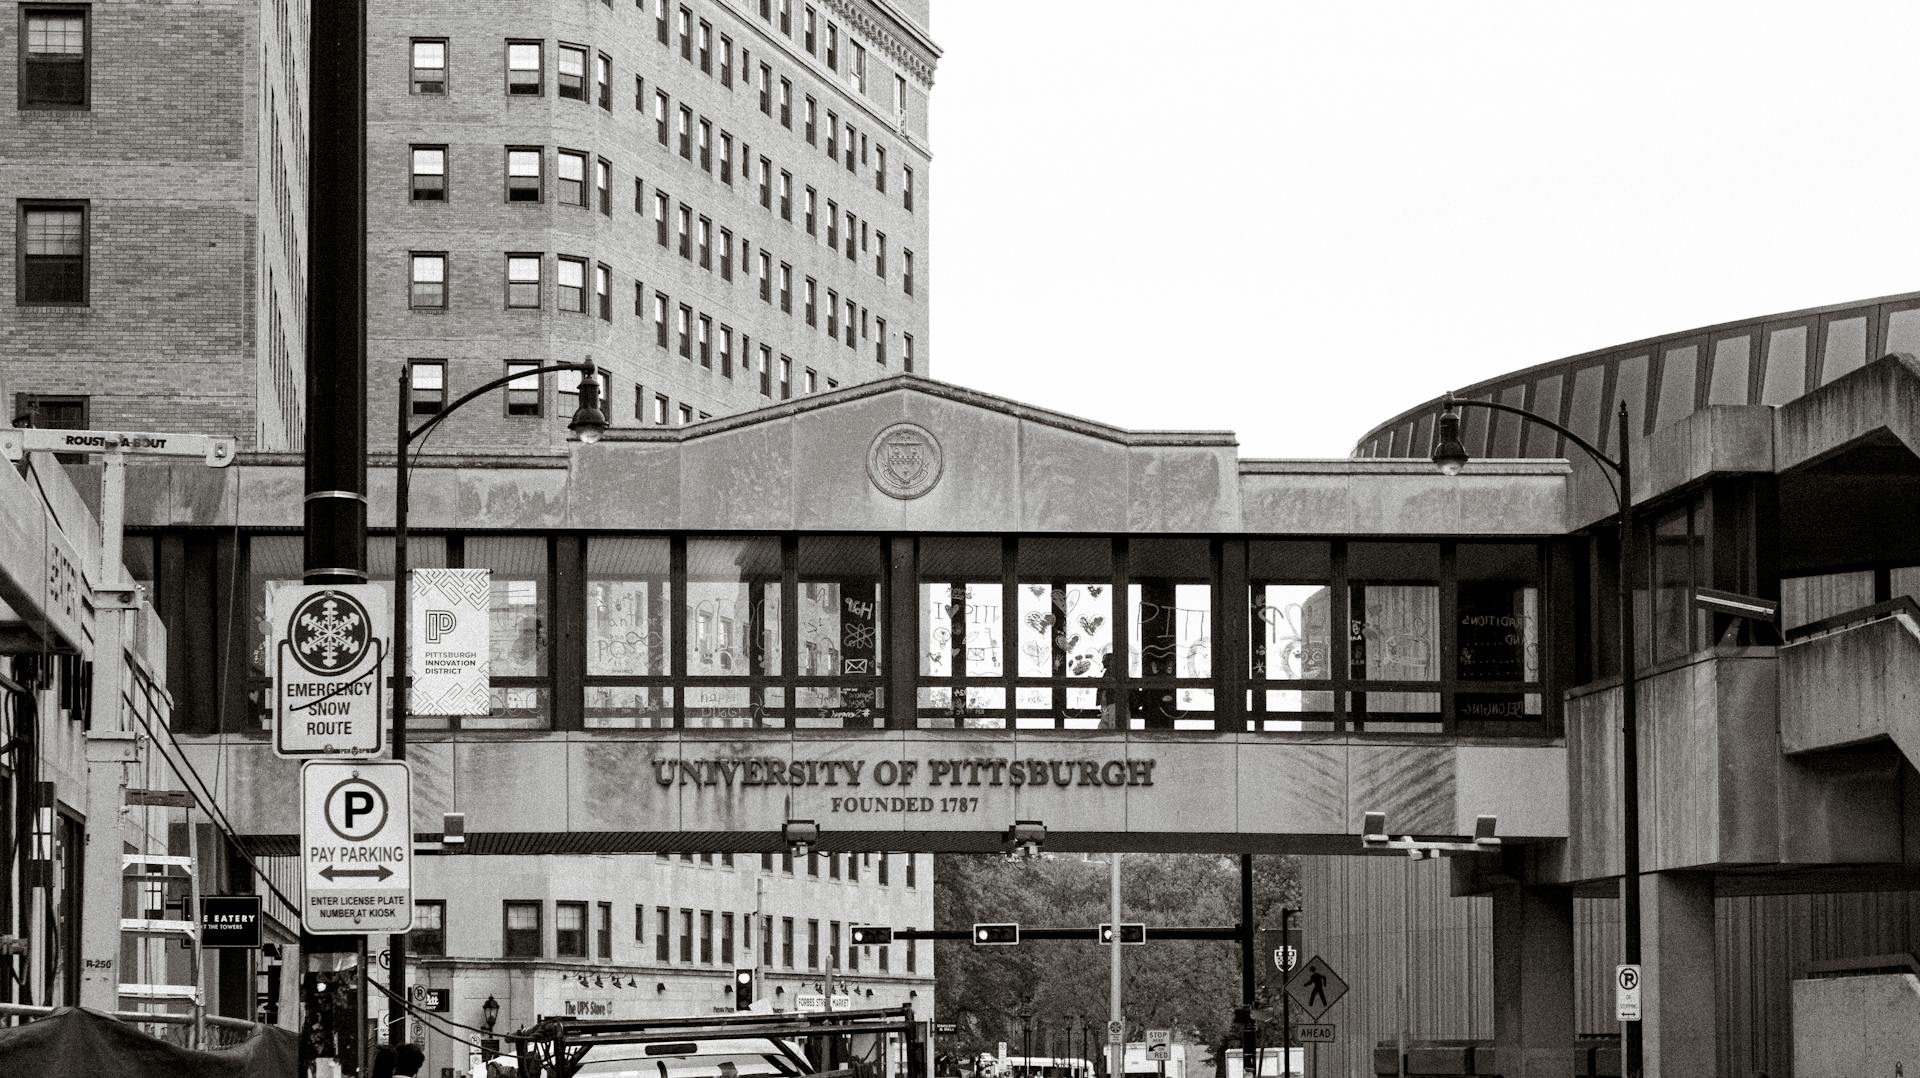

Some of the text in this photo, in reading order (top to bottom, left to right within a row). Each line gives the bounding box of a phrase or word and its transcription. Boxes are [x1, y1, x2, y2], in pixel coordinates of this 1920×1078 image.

[66, 435, 105, 447] ROUST
[287, 682, 372, 697] EMERGENCY
[308, 701, 350, 716] SNOW
[307, 721, 352, 735] ROUTE
[651, 759, 1155, 787] UNIVERSITY OF PITTSBURGH
[345, 791, 374, 828] P
[831, 797, 978, 812] FOUNDED 1787
[310, 846, 404, 862] PAY PARKING
[311, 896, 404, 906] ENTER LICENSE PLATE
[320, 909, 396, 918] NUMBER AT KIOSK
[565, 1001, 605, 1015] The UPS Store
[799, 998, 815, 1007] FORBES
[1149, 1031, 1167, 1039] STOP
[1300, 1029, 1330, 1038] AHEAD
